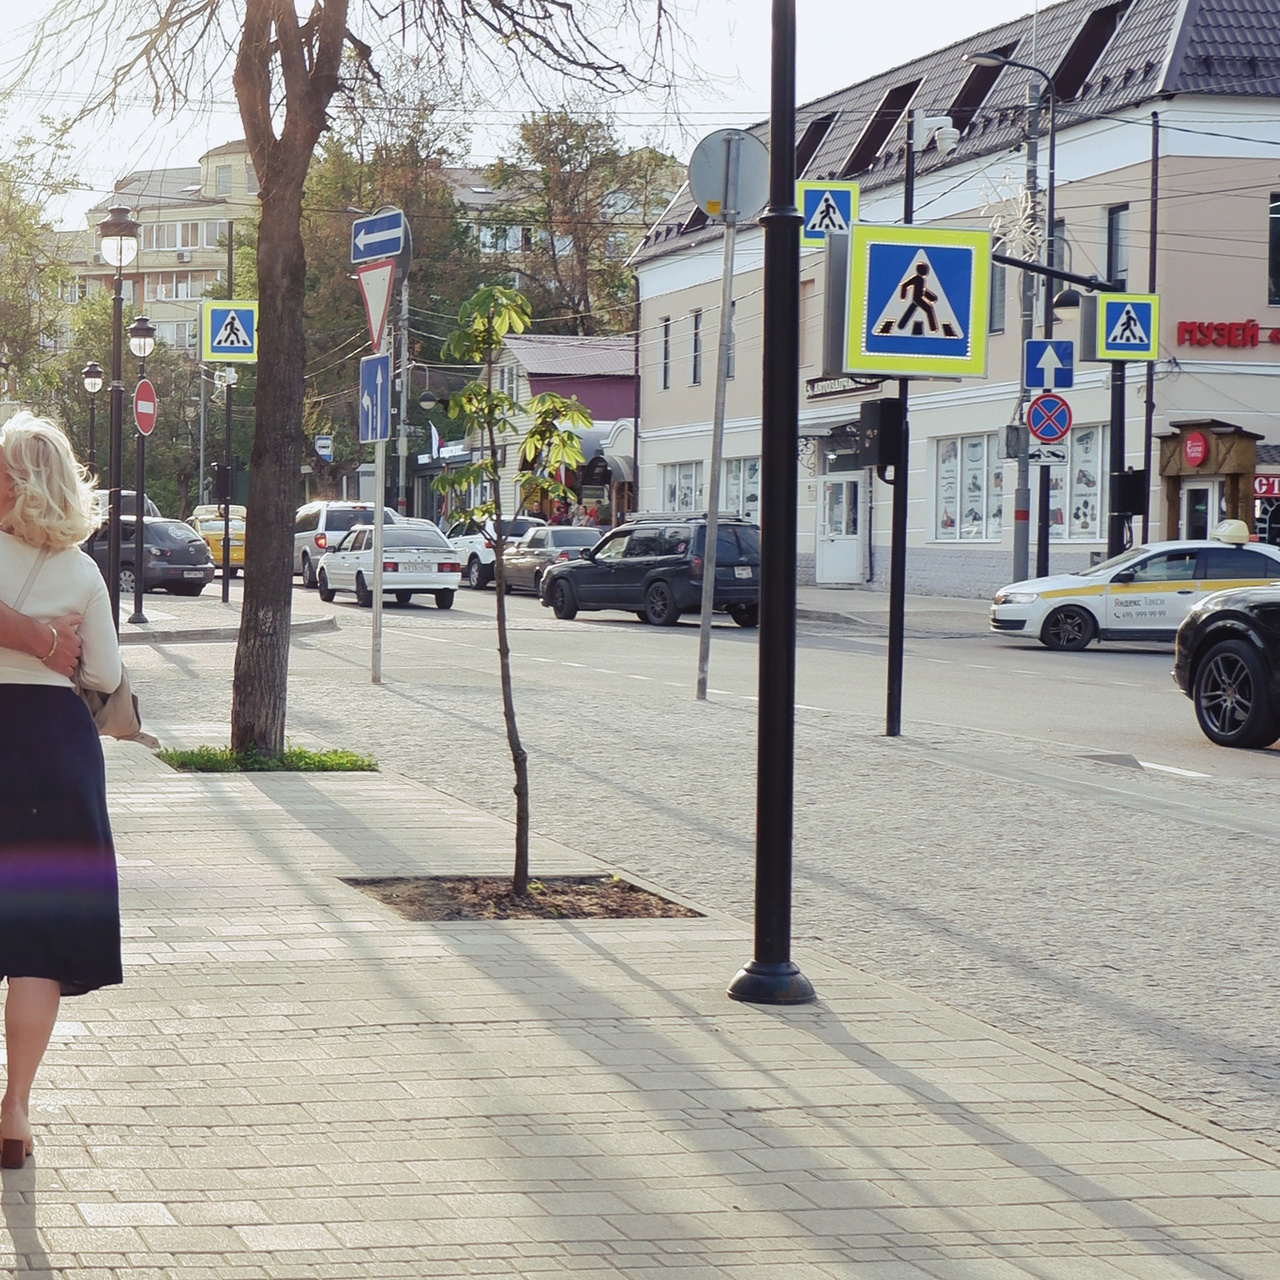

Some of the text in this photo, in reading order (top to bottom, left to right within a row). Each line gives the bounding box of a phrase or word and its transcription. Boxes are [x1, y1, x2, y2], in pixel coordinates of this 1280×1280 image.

[1177, 319, 1259, 348] МУЗЕЙ
[813, 376, 880, 395] АВТОЗАПЧА
[1114, 597, 1165, 607] Яндекс Такси
[1135, 610, 1147, 618] 999
